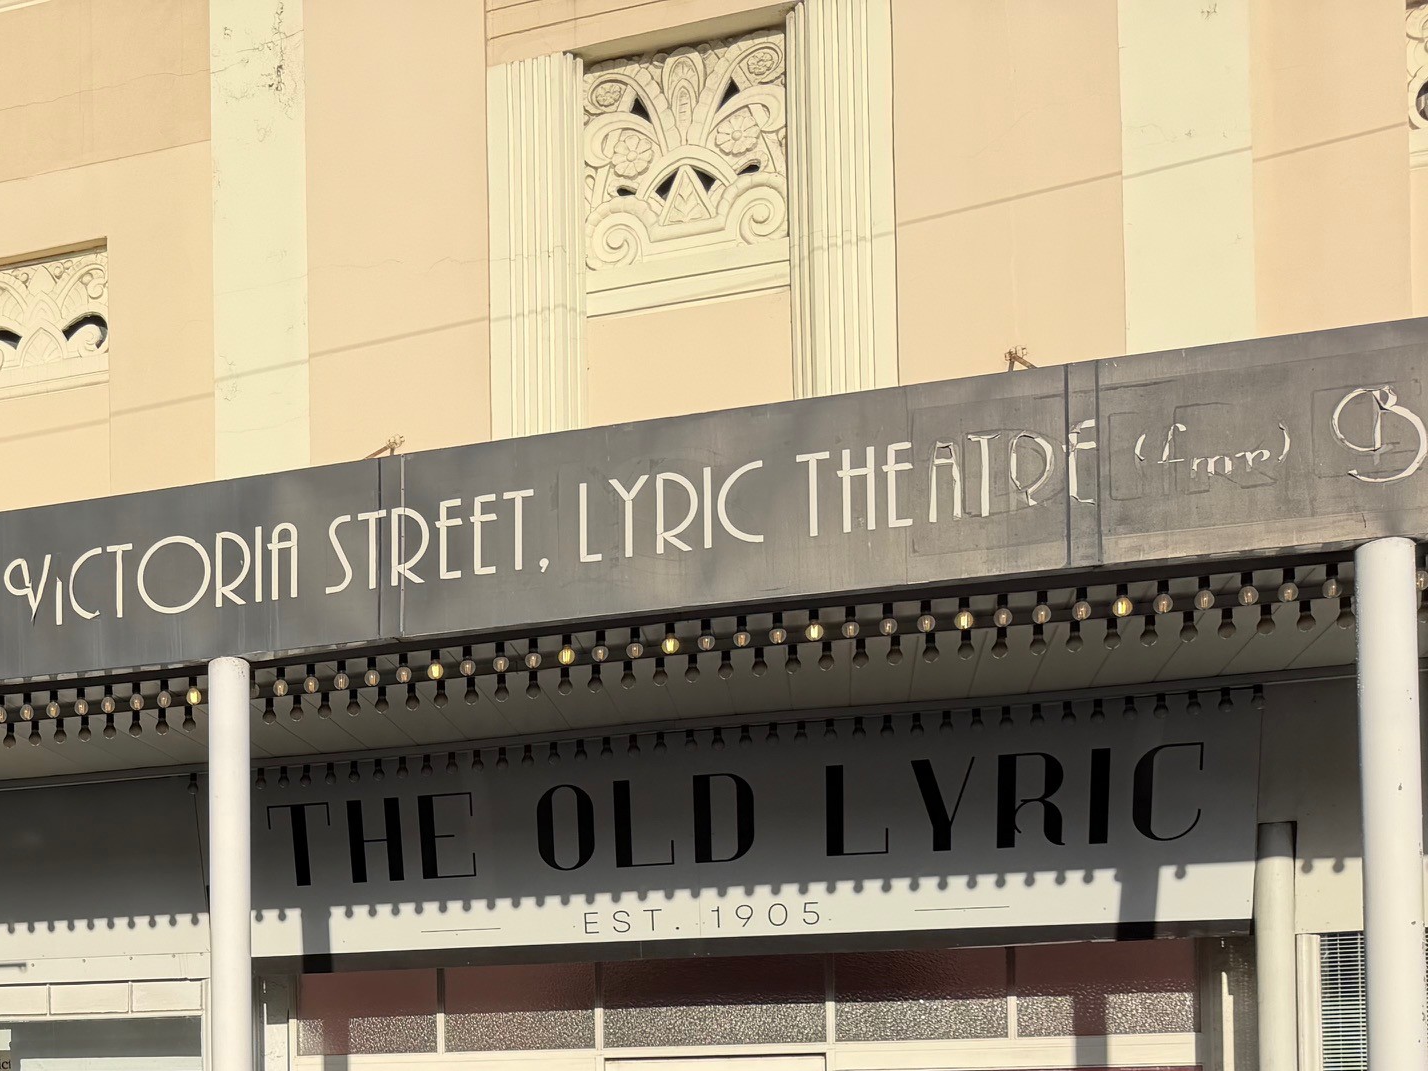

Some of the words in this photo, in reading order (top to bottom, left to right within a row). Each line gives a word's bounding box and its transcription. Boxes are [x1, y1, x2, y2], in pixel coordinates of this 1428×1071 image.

[3, 521, 299, 627] VICTORIA
[325, 488, 551, 596] STREET,
[578, 459, 765, 563] LYRIC
[795, 418, 1098, 537] THEATRE
[266, 791, 478, 887] THE
[536, 772, 756, 872] OLD
[825, 741, 1205, 857] LYRIC
[583, 907, 681, 935] EST.
[710, 900, 821, 930] 1905
